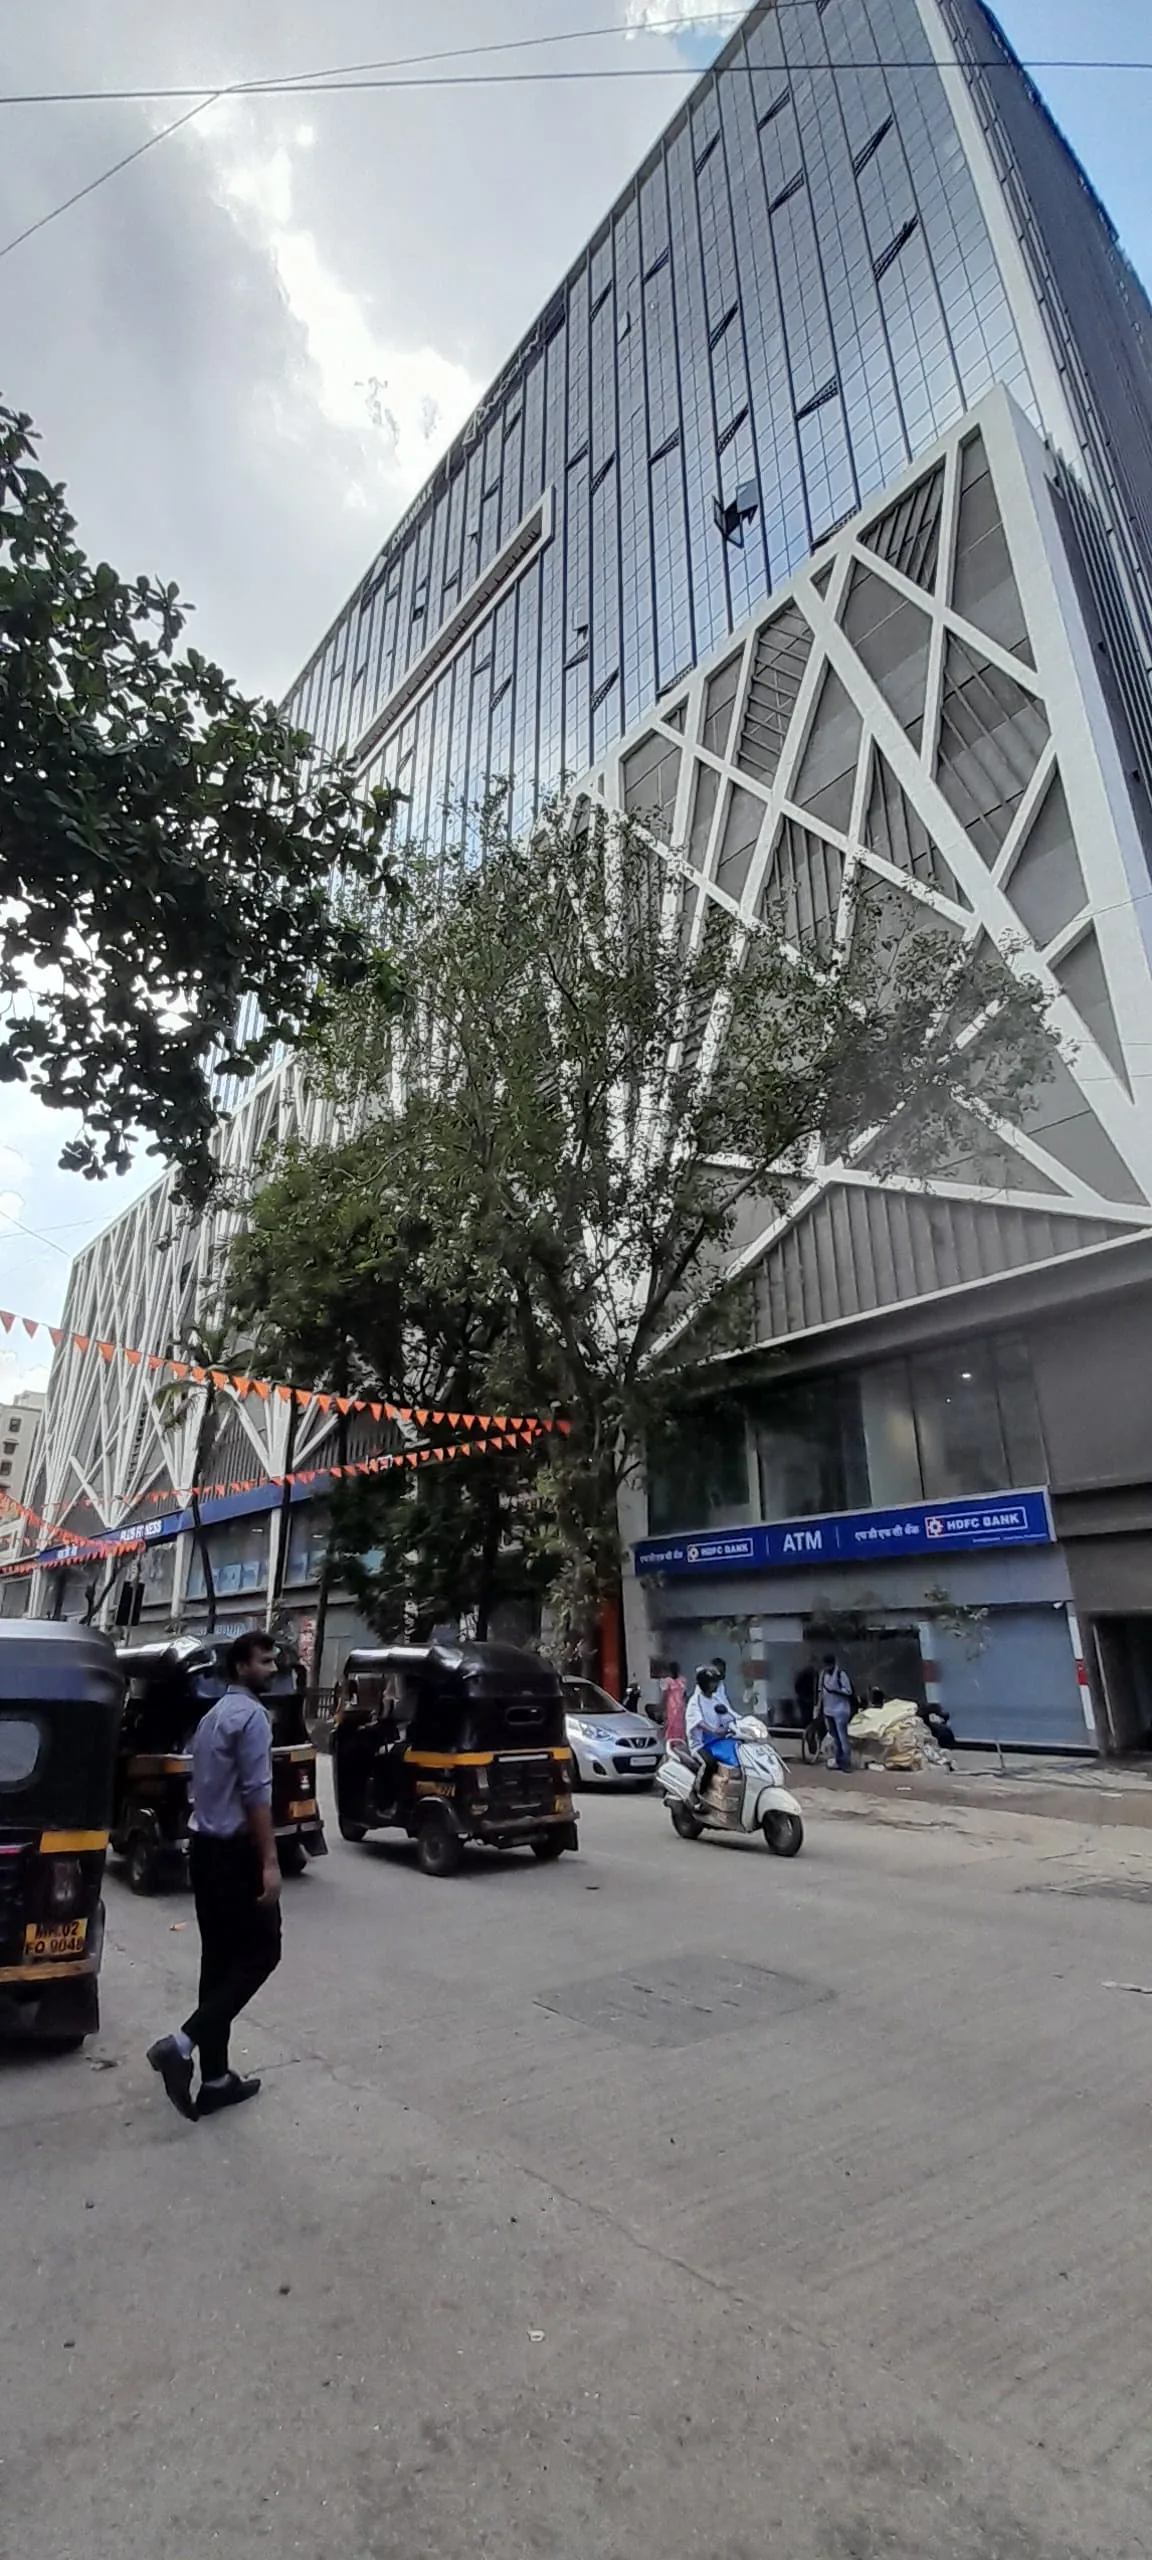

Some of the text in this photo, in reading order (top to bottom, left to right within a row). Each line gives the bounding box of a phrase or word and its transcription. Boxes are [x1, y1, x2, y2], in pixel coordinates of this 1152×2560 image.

[947, 1513, 1019, 1531] HDFC BANK
[701, 1543, 749, 1557] HDFC BANK
[783, 1530, 822, 1552] ATM
